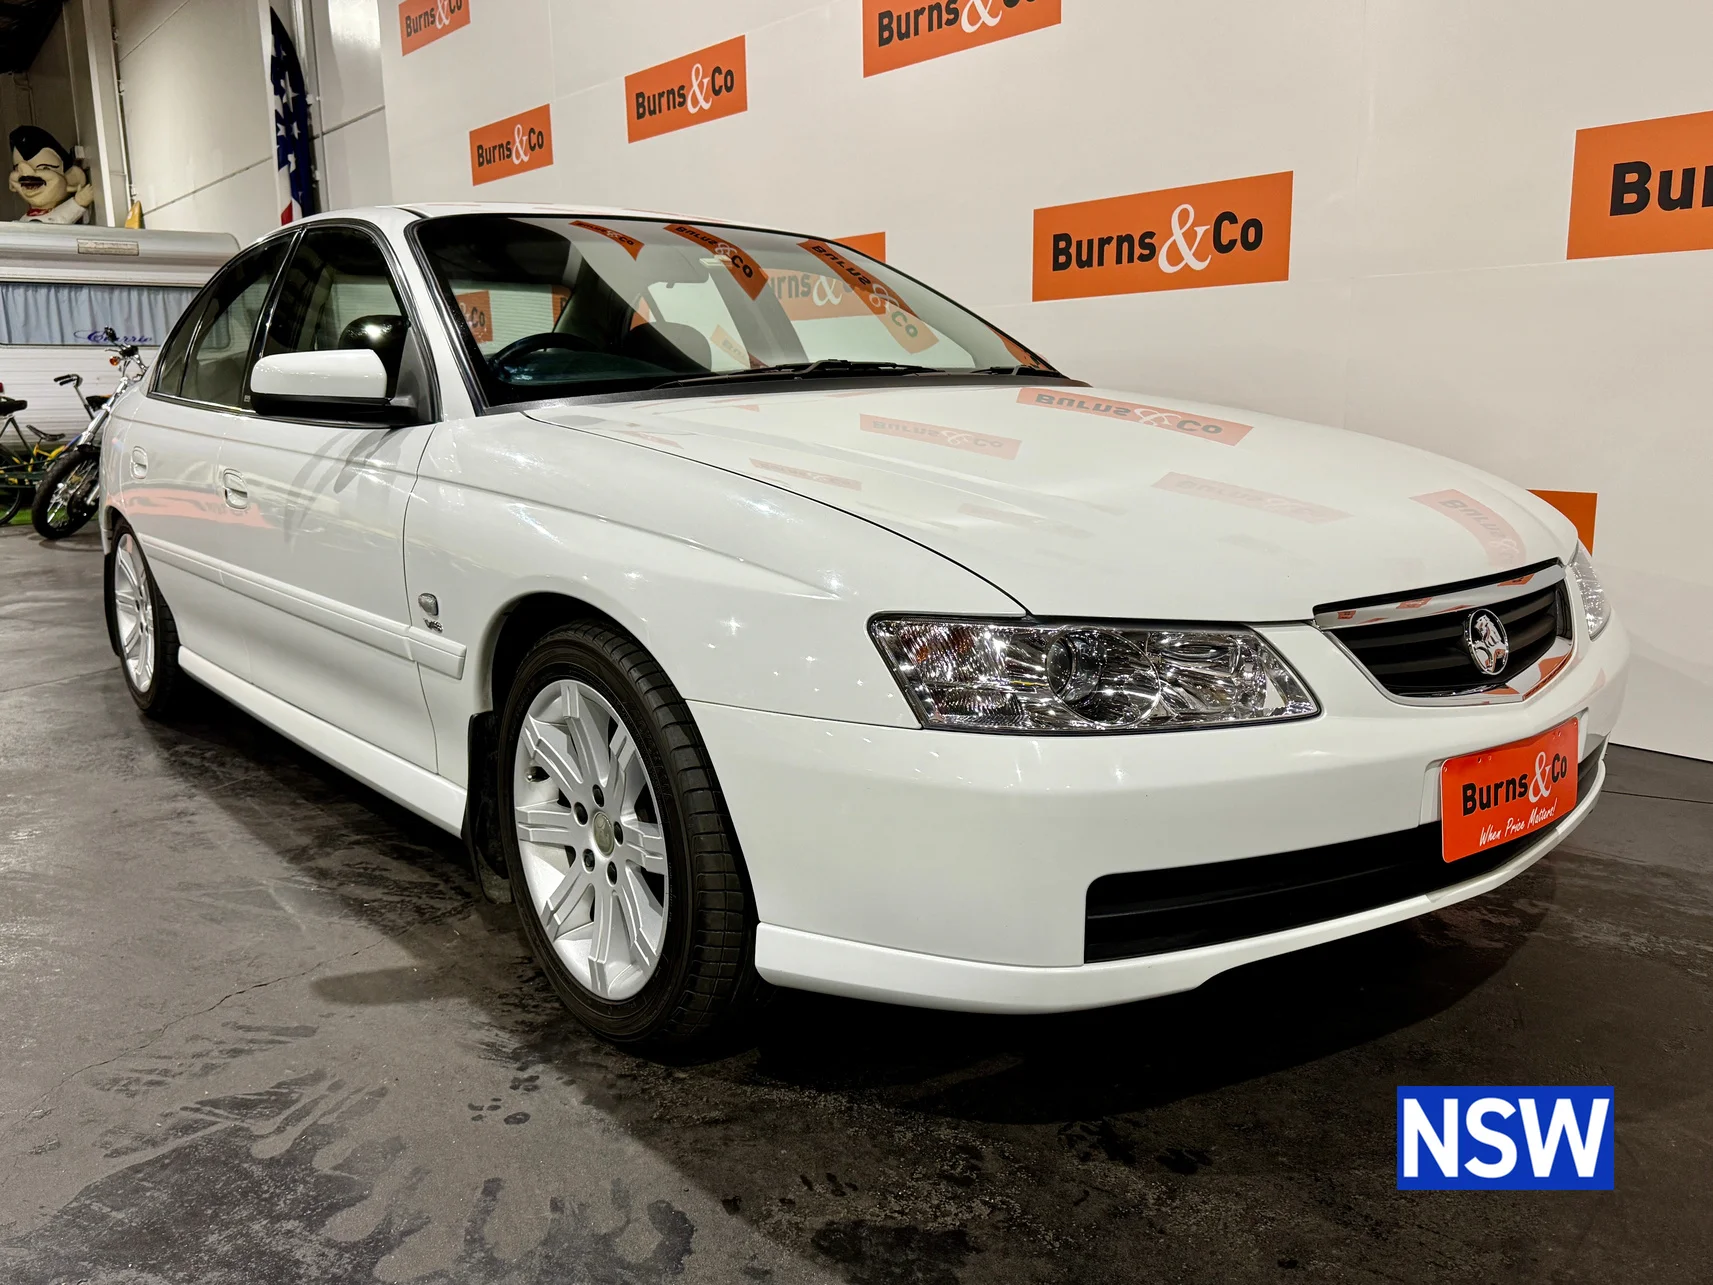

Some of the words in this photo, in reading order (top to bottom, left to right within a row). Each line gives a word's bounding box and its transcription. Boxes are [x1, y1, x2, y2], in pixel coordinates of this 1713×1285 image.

[877, 0, 1036, 48] Burns&
[635, 63, 735, 120] Burns&Co
[476, 124, 544, 168] Burns&Co
[1052, 203, 1264, 274] Burns&Co
[1462, 752, 1567, 817] Burns&Co
[1479, 823, 1501, 847] When
[1504, 817, 1525, 837] Price
[1527, 797, 1558, 829] Matters!
